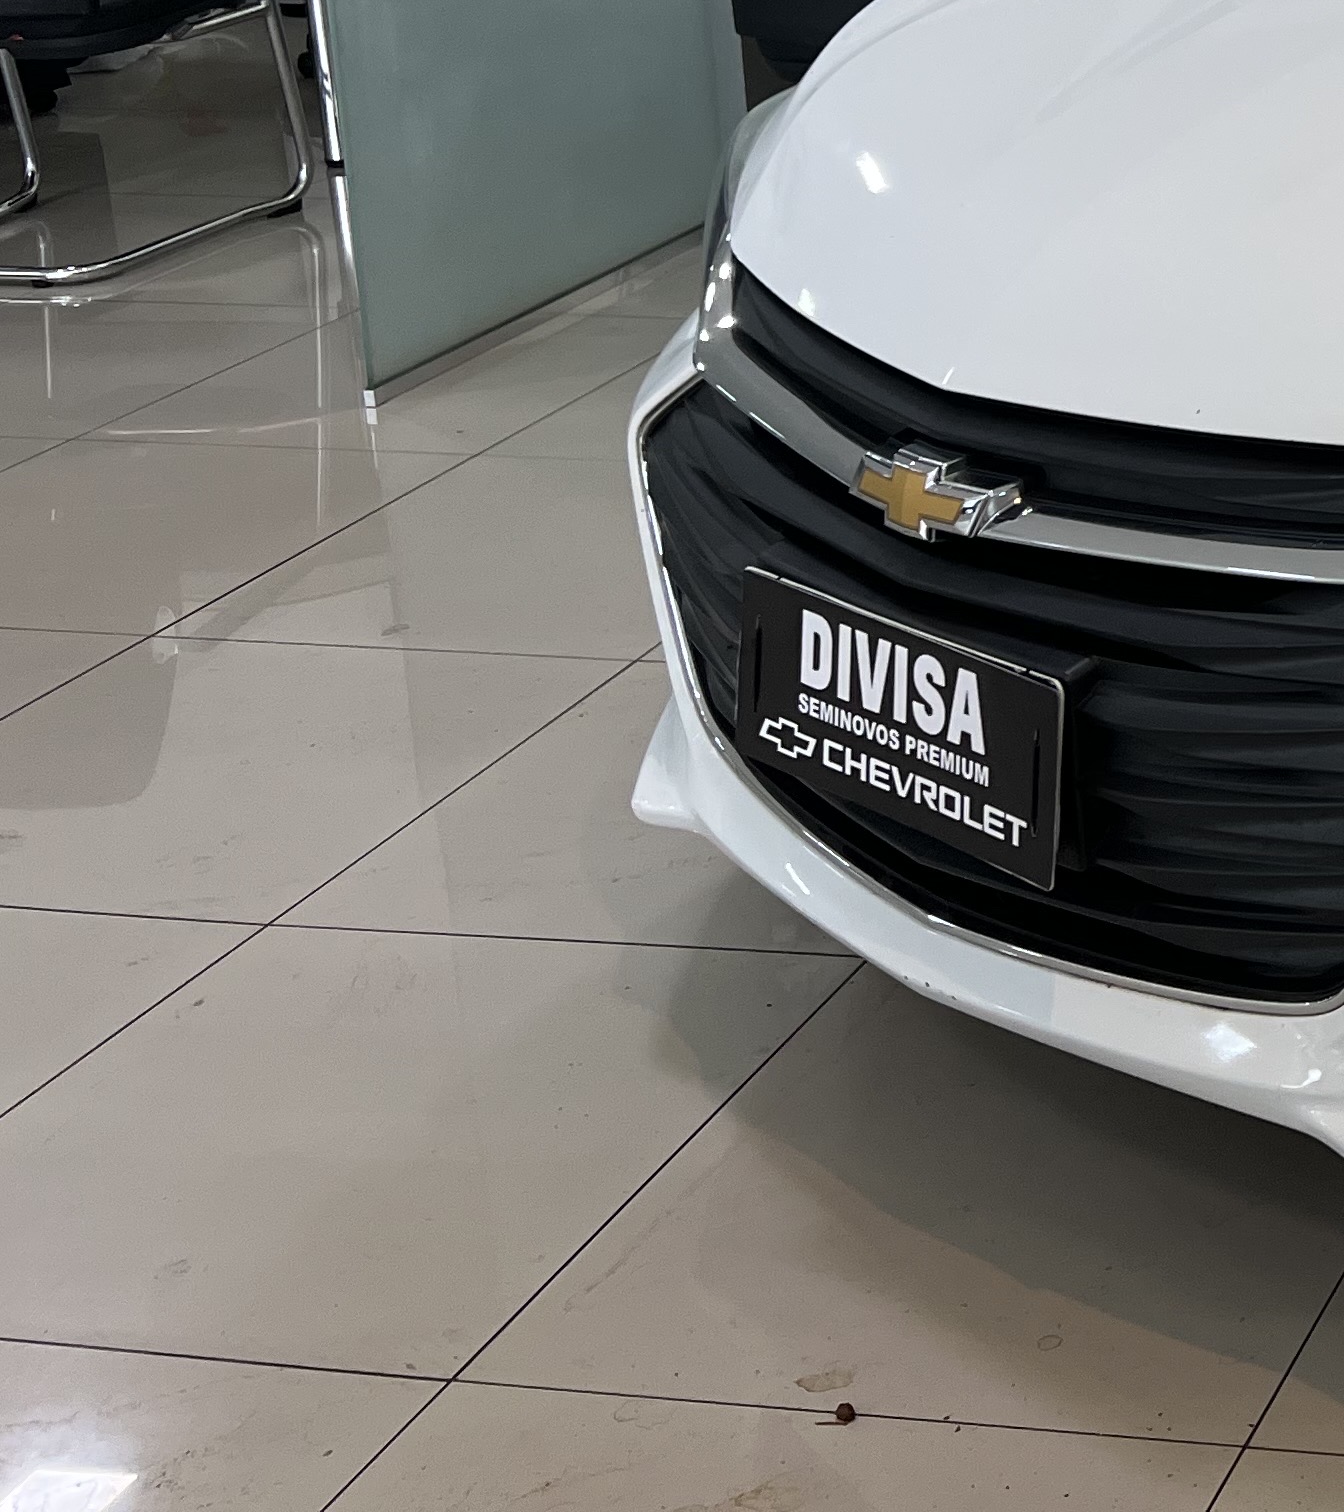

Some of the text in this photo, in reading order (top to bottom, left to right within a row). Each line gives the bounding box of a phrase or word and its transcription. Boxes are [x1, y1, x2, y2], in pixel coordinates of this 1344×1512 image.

[800, 608, 986, 756] DIVISA
[798, 692, 990, 787] SEMINOVOS PREMIUM
[821, 738, 1028, 847] CHEVROLET
